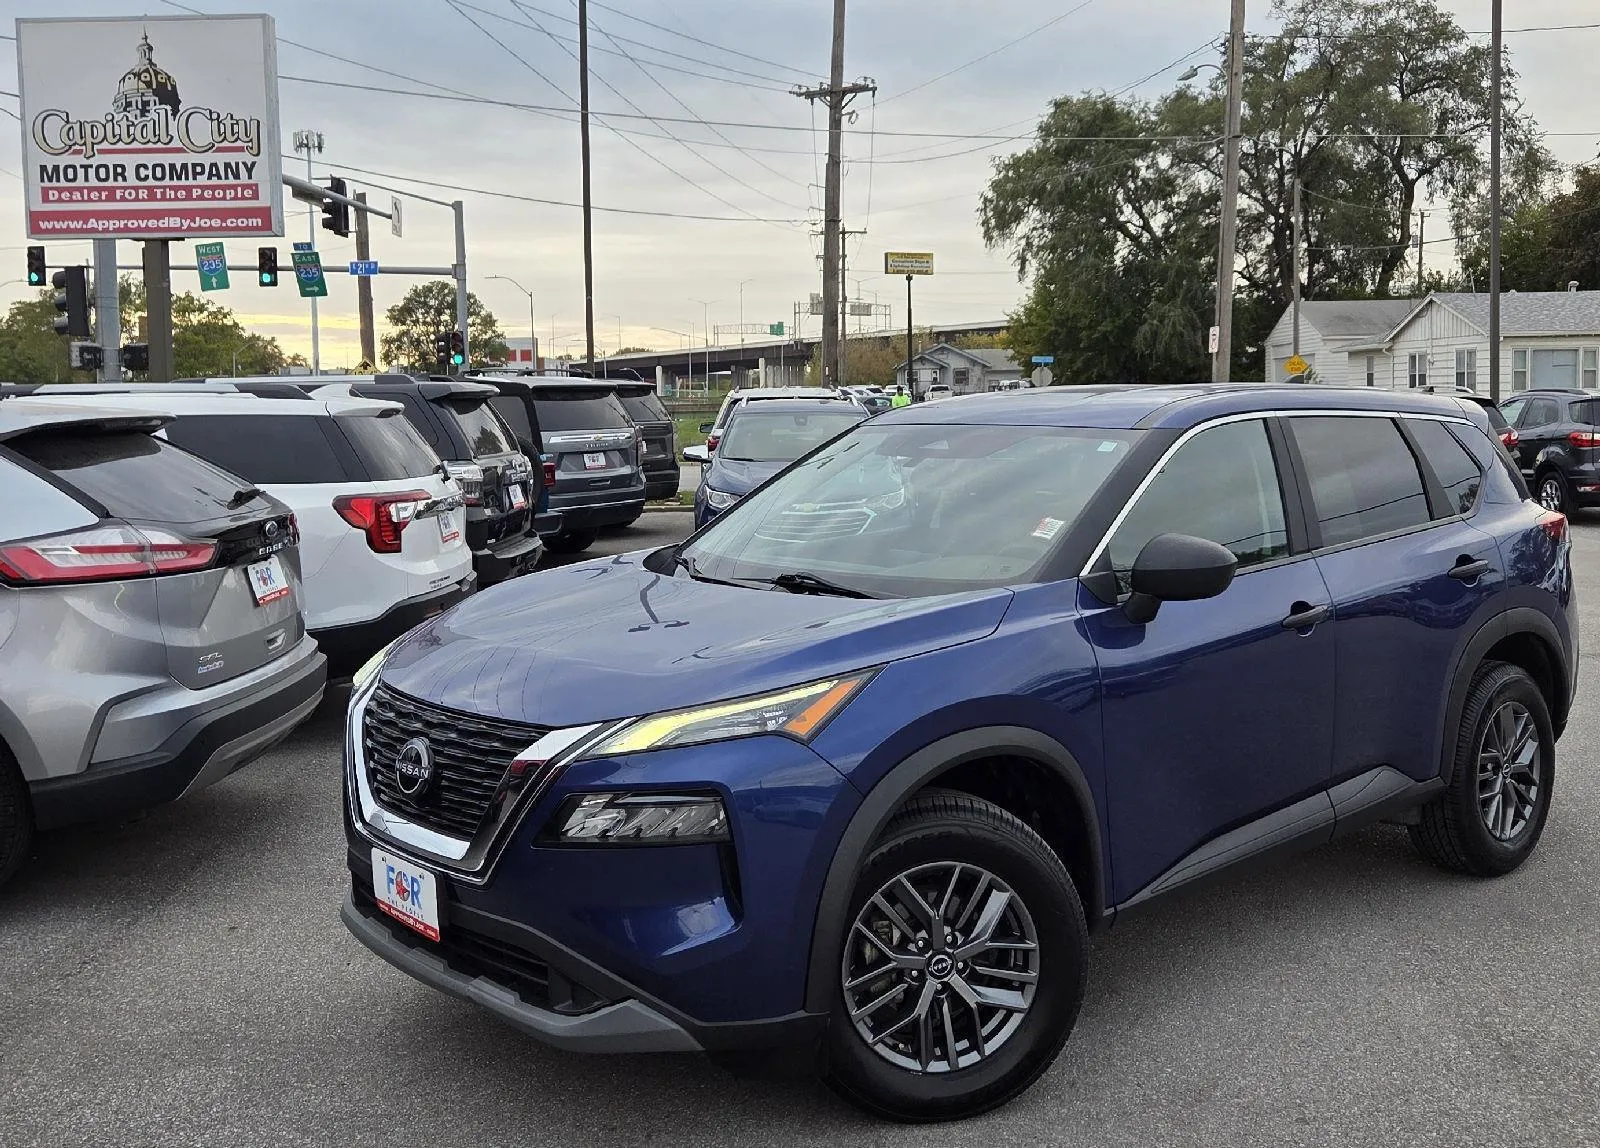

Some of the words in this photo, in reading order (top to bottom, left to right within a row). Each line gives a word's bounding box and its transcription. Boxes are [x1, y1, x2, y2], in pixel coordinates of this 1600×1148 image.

[32, 107, 174, 159] Capital
[176, 106, 261, 157] City
[39, 163, 128, 184] MOTOR
[134, 160, 257, 183] COMPANY
[48, 188, 109, 201] Dealer
[115, 188, 149, 200] FOR
[154, 187, 186, 199] The
[192, 186, 253, 200] People
[39, 215, 262, 231] www.ApprovedByJoe.com
[198, 245, 221, 254] WEST
[202, 258, 222, 271] 235
[294, 254, 316, 262] EAST
[300, 267, 319, 278] 235
[386, 864, 423, 910] FOR
